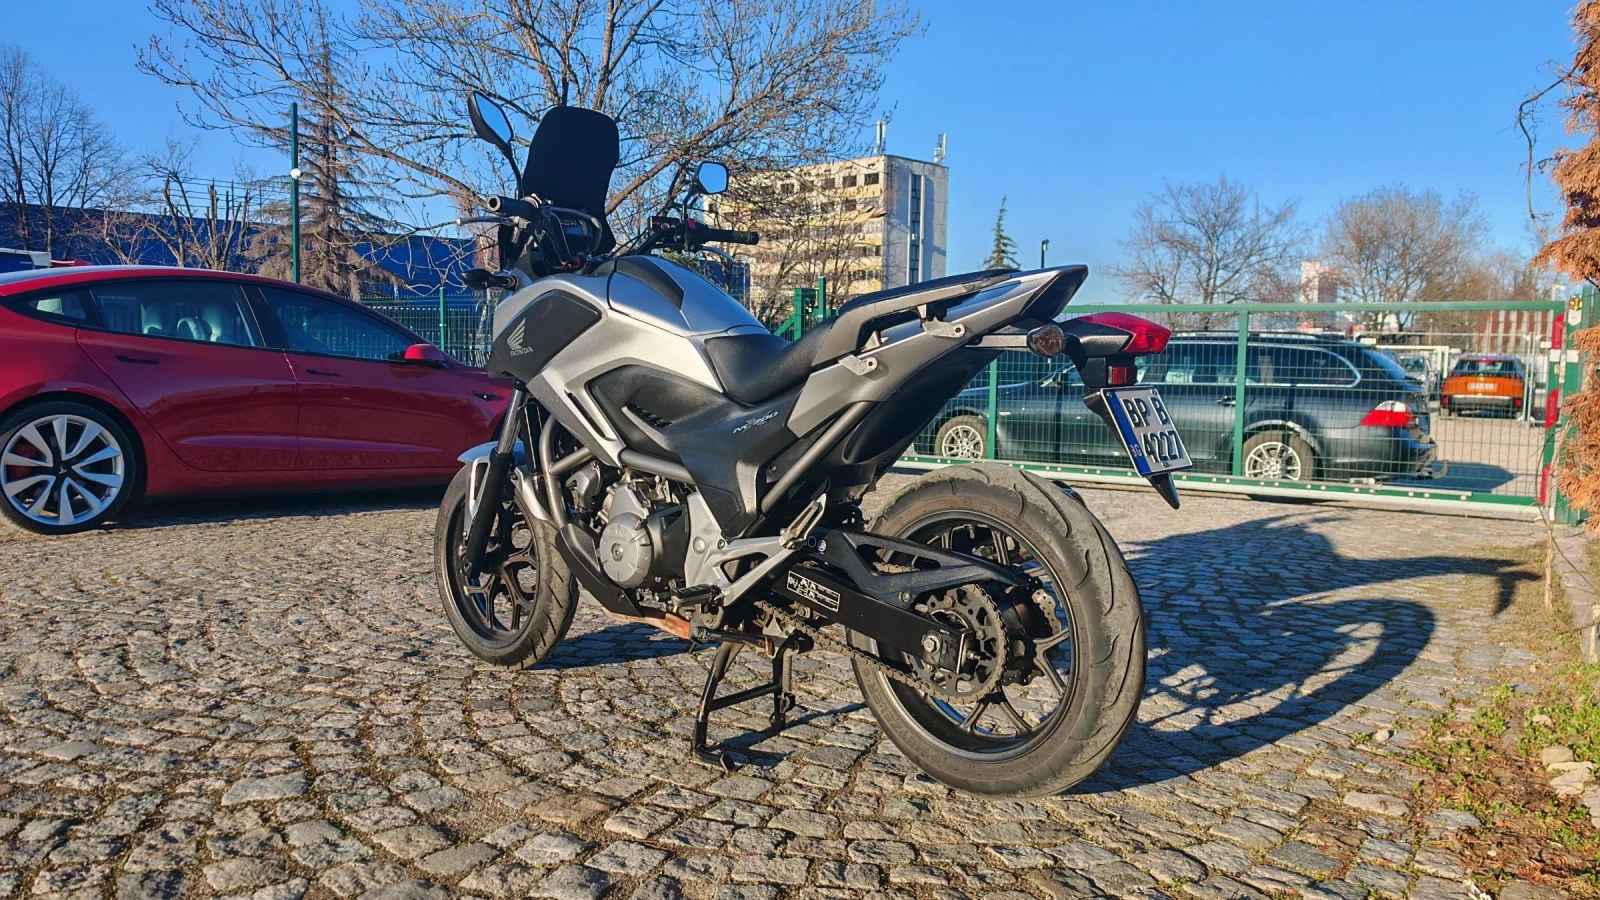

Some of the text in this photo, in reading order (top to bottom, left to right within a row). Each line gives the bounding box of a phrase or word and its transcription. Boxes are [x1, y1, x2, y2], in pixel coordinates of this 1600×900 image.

[510, 346, 534, 357] HONDA
[1120, 396, 1171, 428] BP B
[1141, 430, 1184, 463] 4227
[866, 681, 930, 758] METZELER
